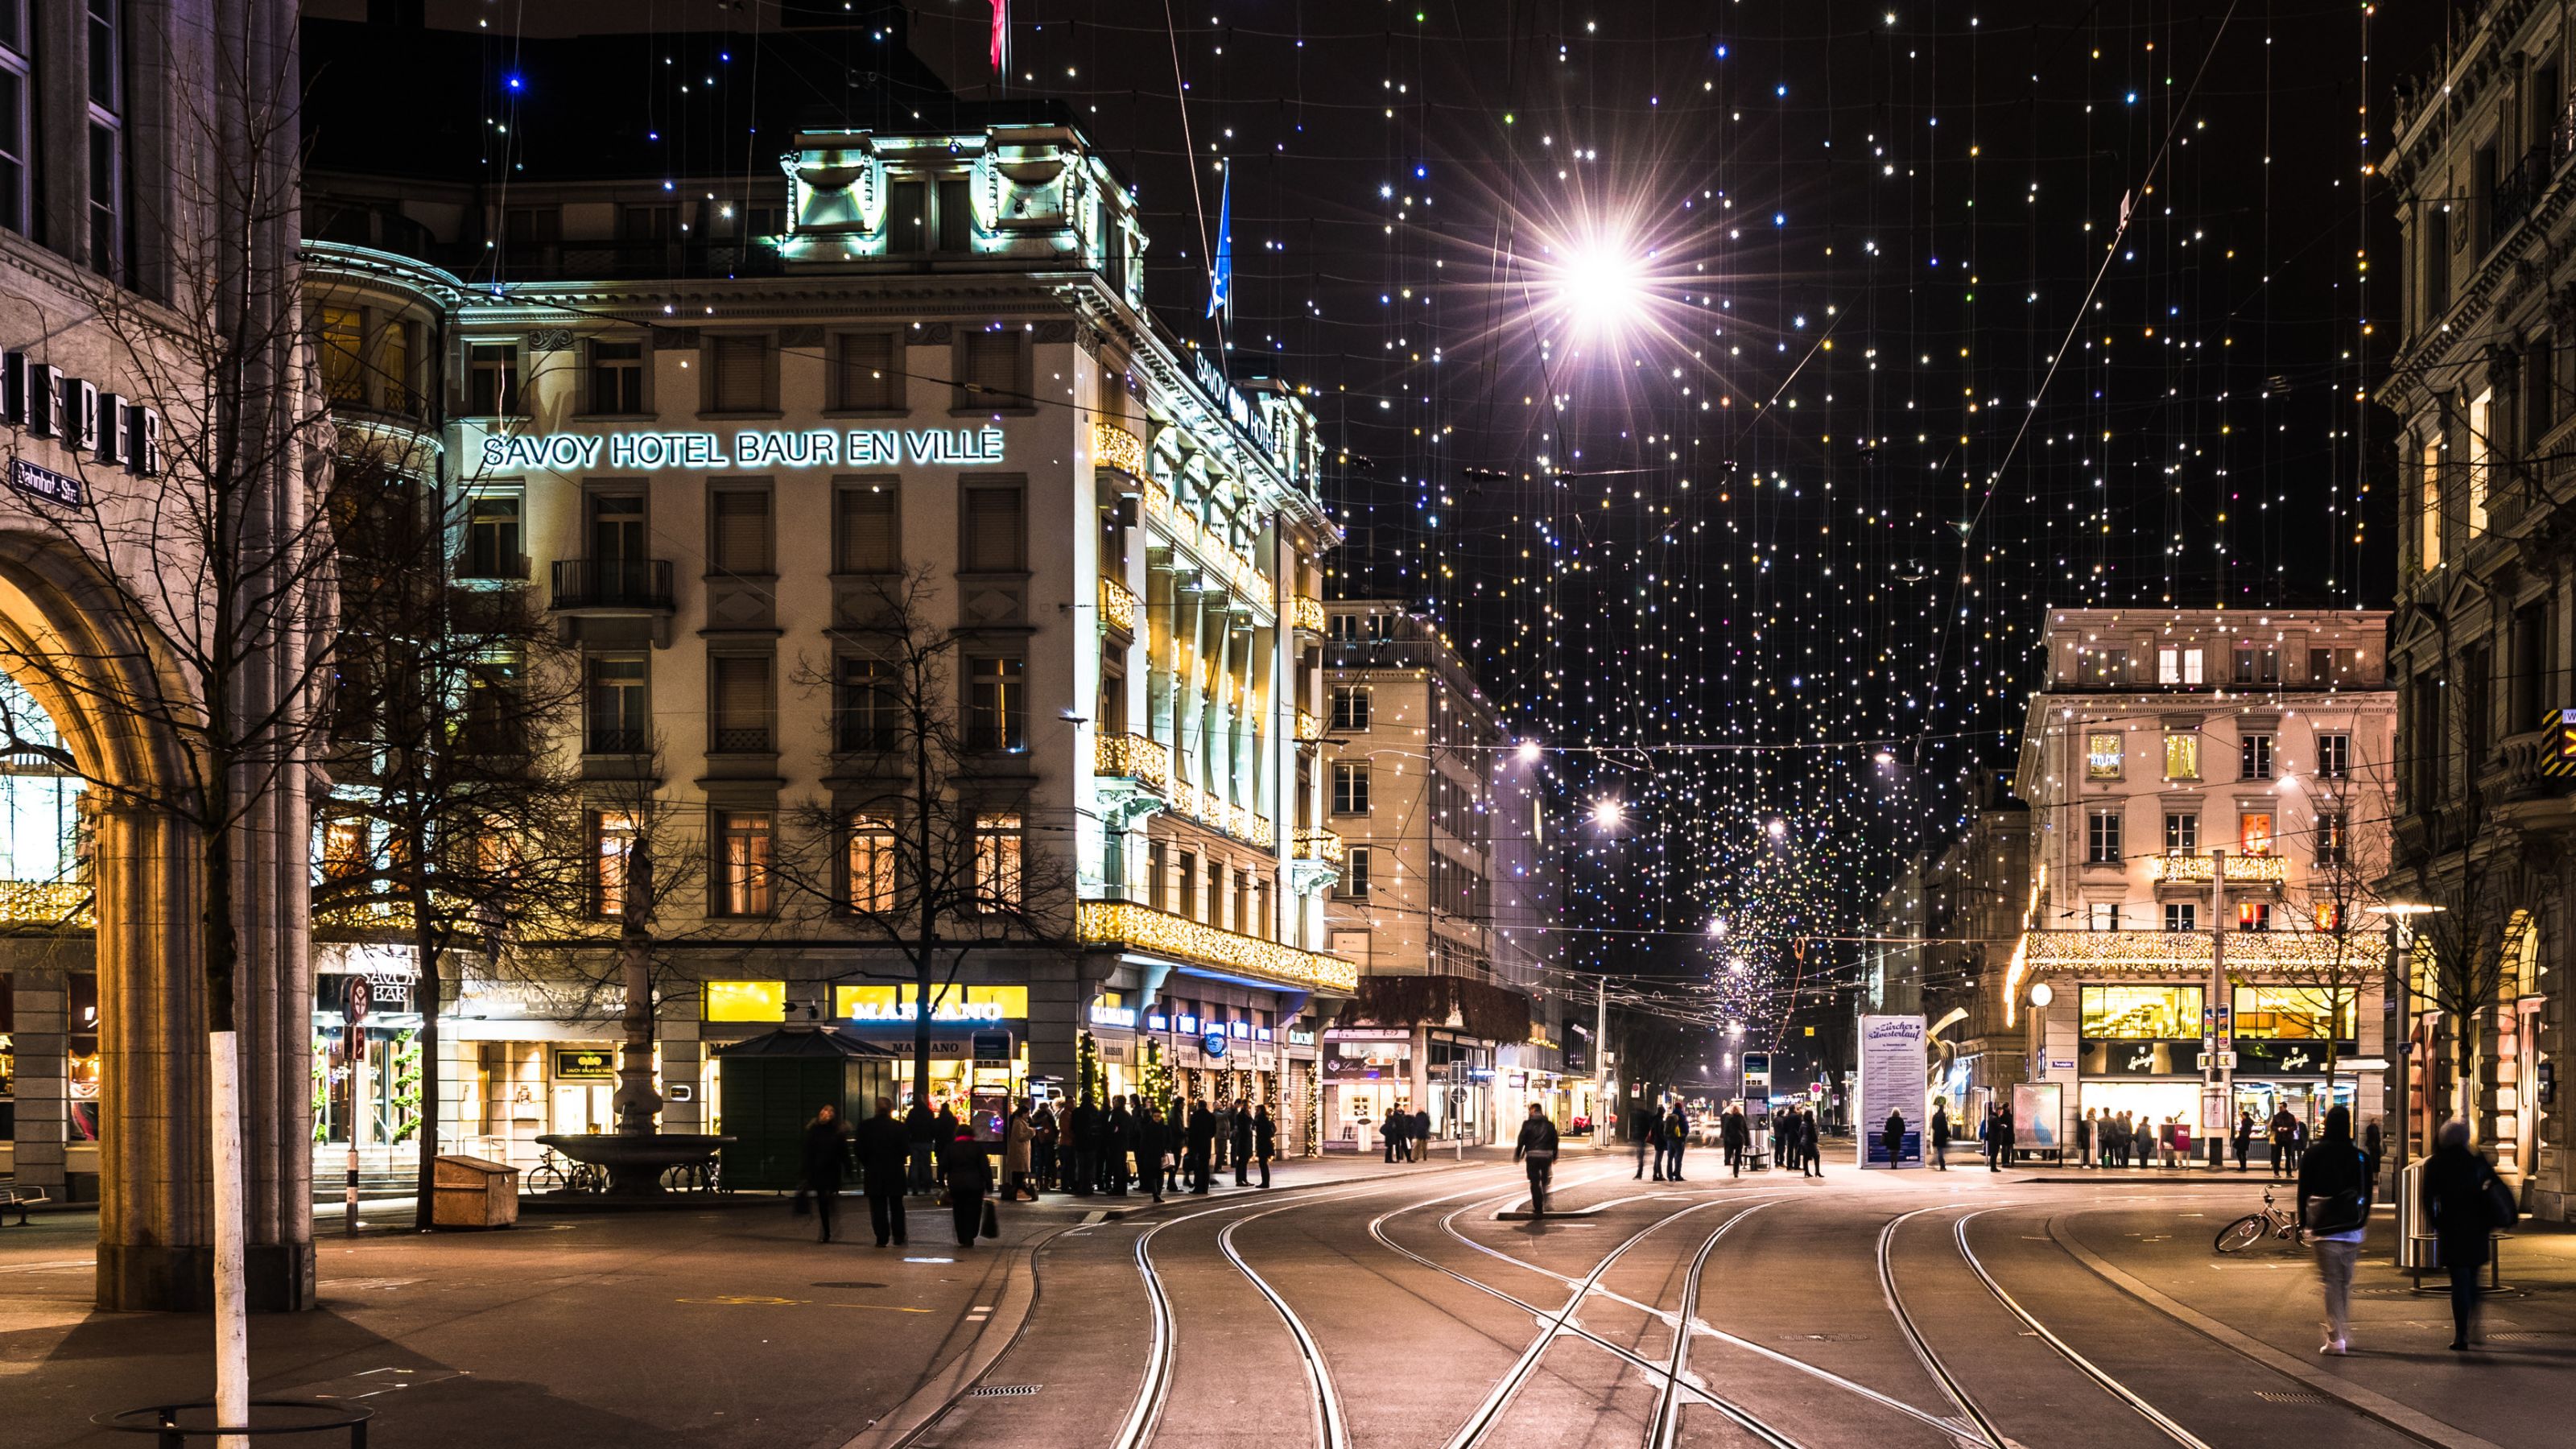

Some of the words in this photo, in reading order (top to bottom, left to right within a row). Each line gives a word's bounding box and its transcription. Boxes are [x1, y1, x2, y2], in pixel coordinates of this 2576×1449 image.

[1197, 351, 1227, 405] SAVOY
[0, 344, 160, 476] IEDER
[483, 436, 601, 465] SAVOY
[613, 436, 726, 464] HOTEL
[738, 433, 834, 462] BAUR
[848, 432, 894, 460] EN
[906, 431, 1001, 460] VILLE
[373, 986, 407, 1001] BAR
[1868, 1029, 1921, 1042] Silvesterlauf
[1880, 1022, 1913, 1031] Zürcher
